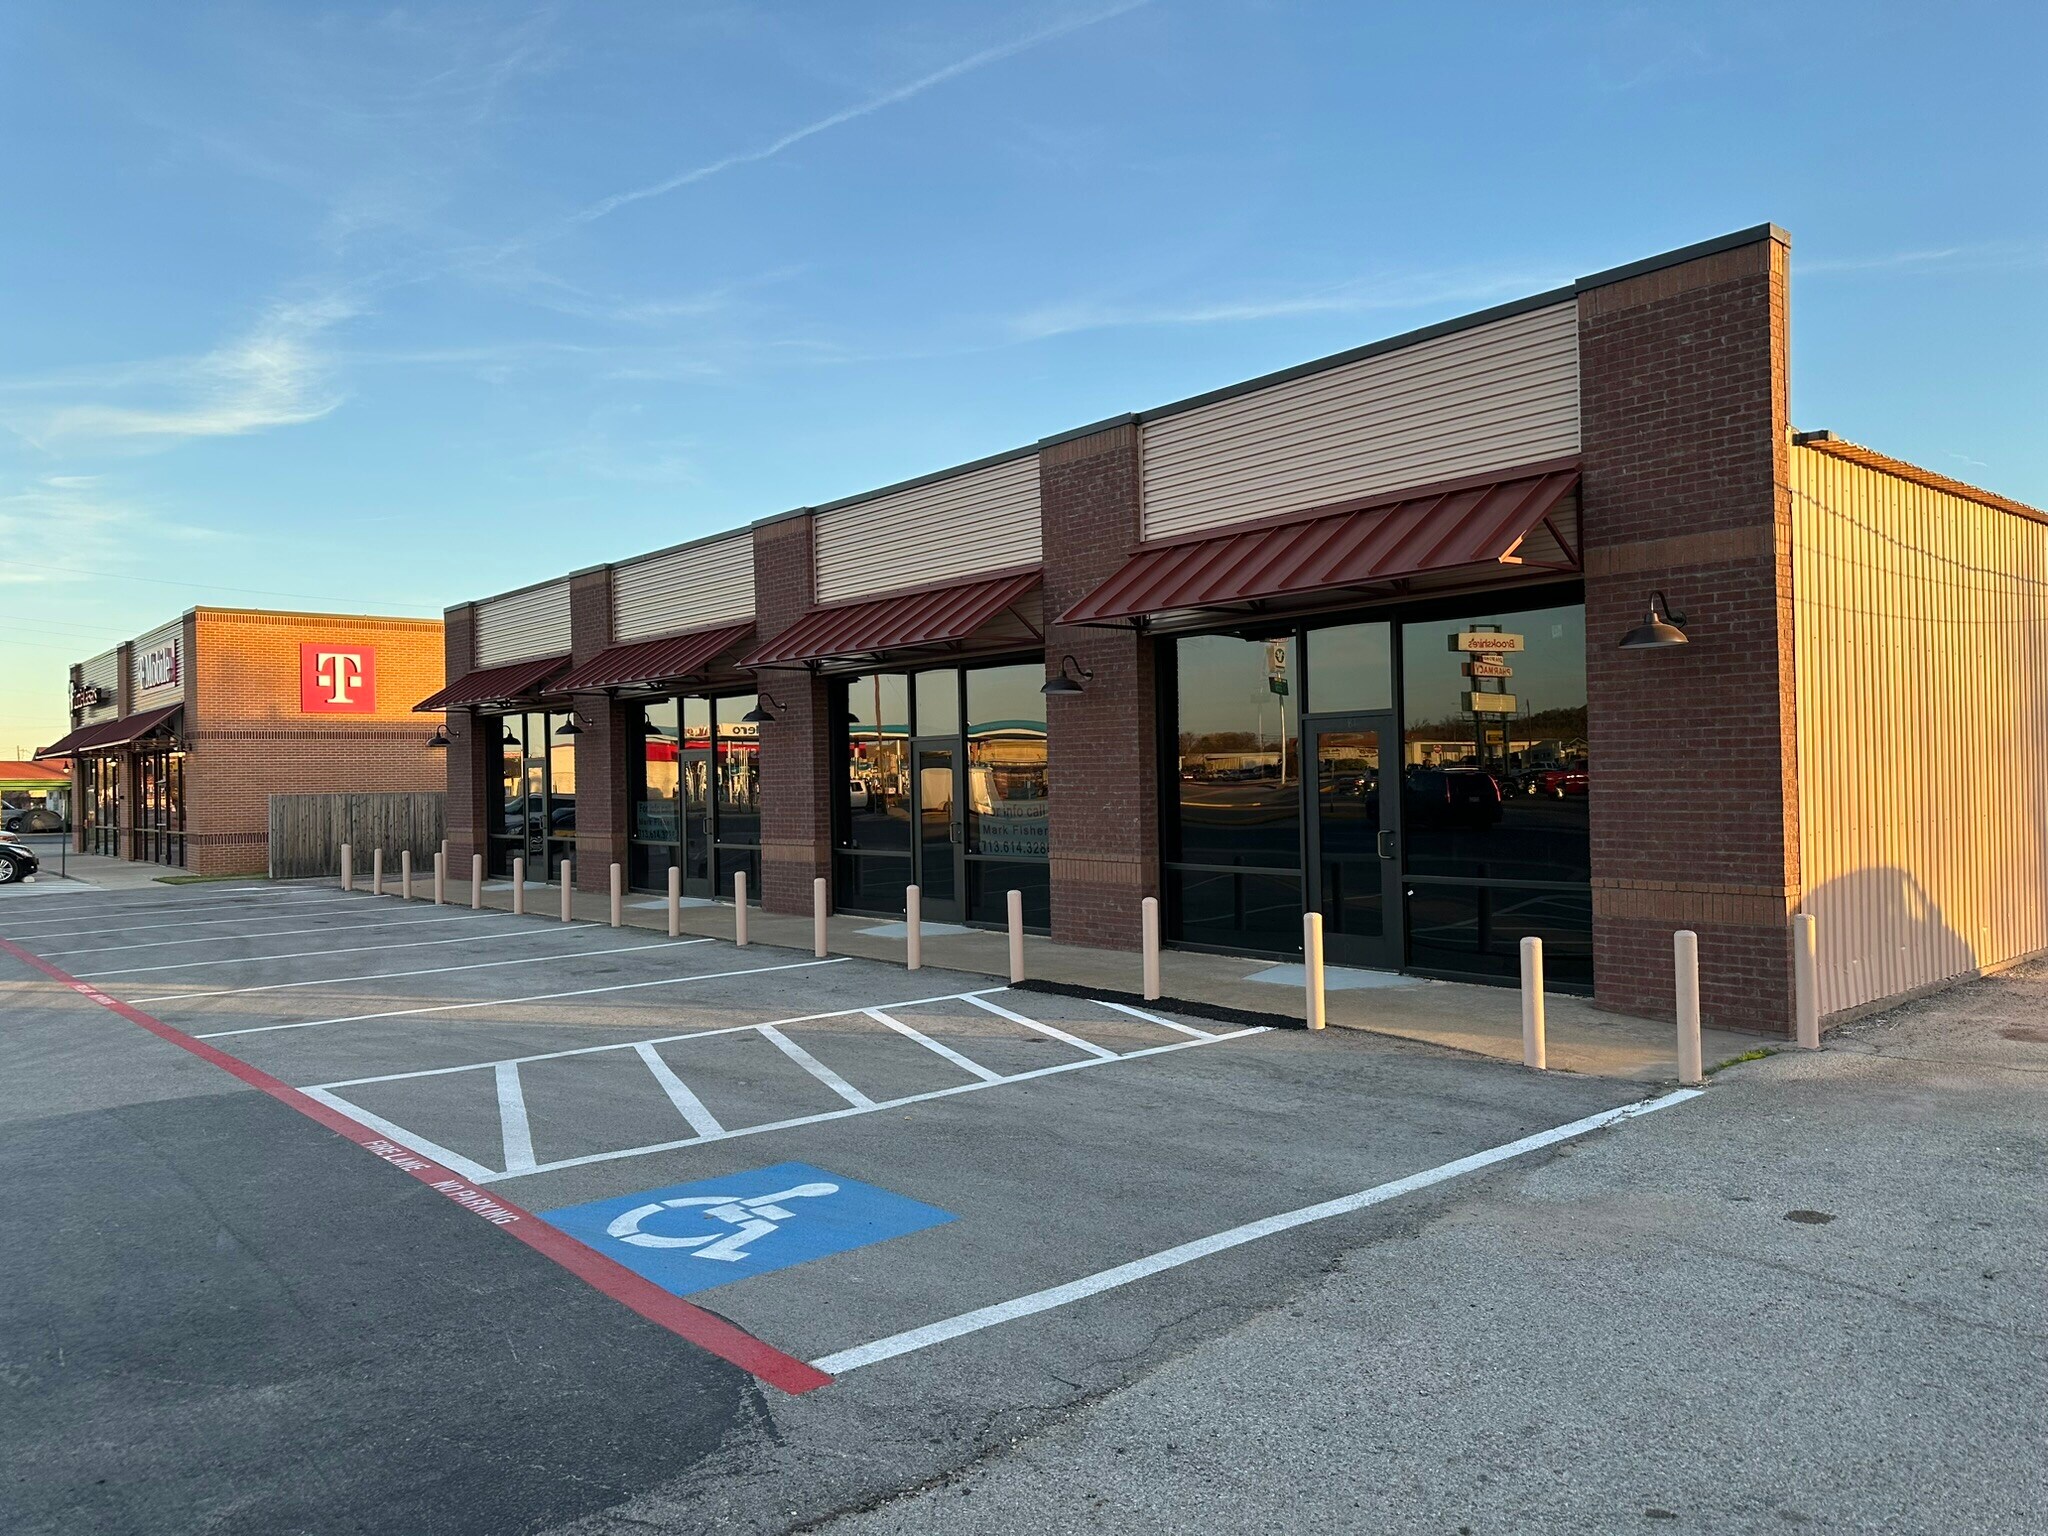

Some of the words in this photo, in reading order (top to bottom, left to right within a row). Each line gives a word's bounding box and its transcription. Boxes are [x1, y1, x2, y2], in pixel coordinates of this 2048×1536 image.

[317, 652, 362, 704] T
[1003, 804, 1024, 817] info
[1026, 804, 1046, 818] call
[983, 825, 1008, 835] Mark
[1013, 825, 1048, 836] Fisher
[981, 841, 1049, 854] 713.614.328
[361, 1140, 402, 1156] FIRE
[383, 1153, 431, 1172] LANE
[429, 1180, 464, 1193] NO
[446, 1190, 520, 1225] PARKING
